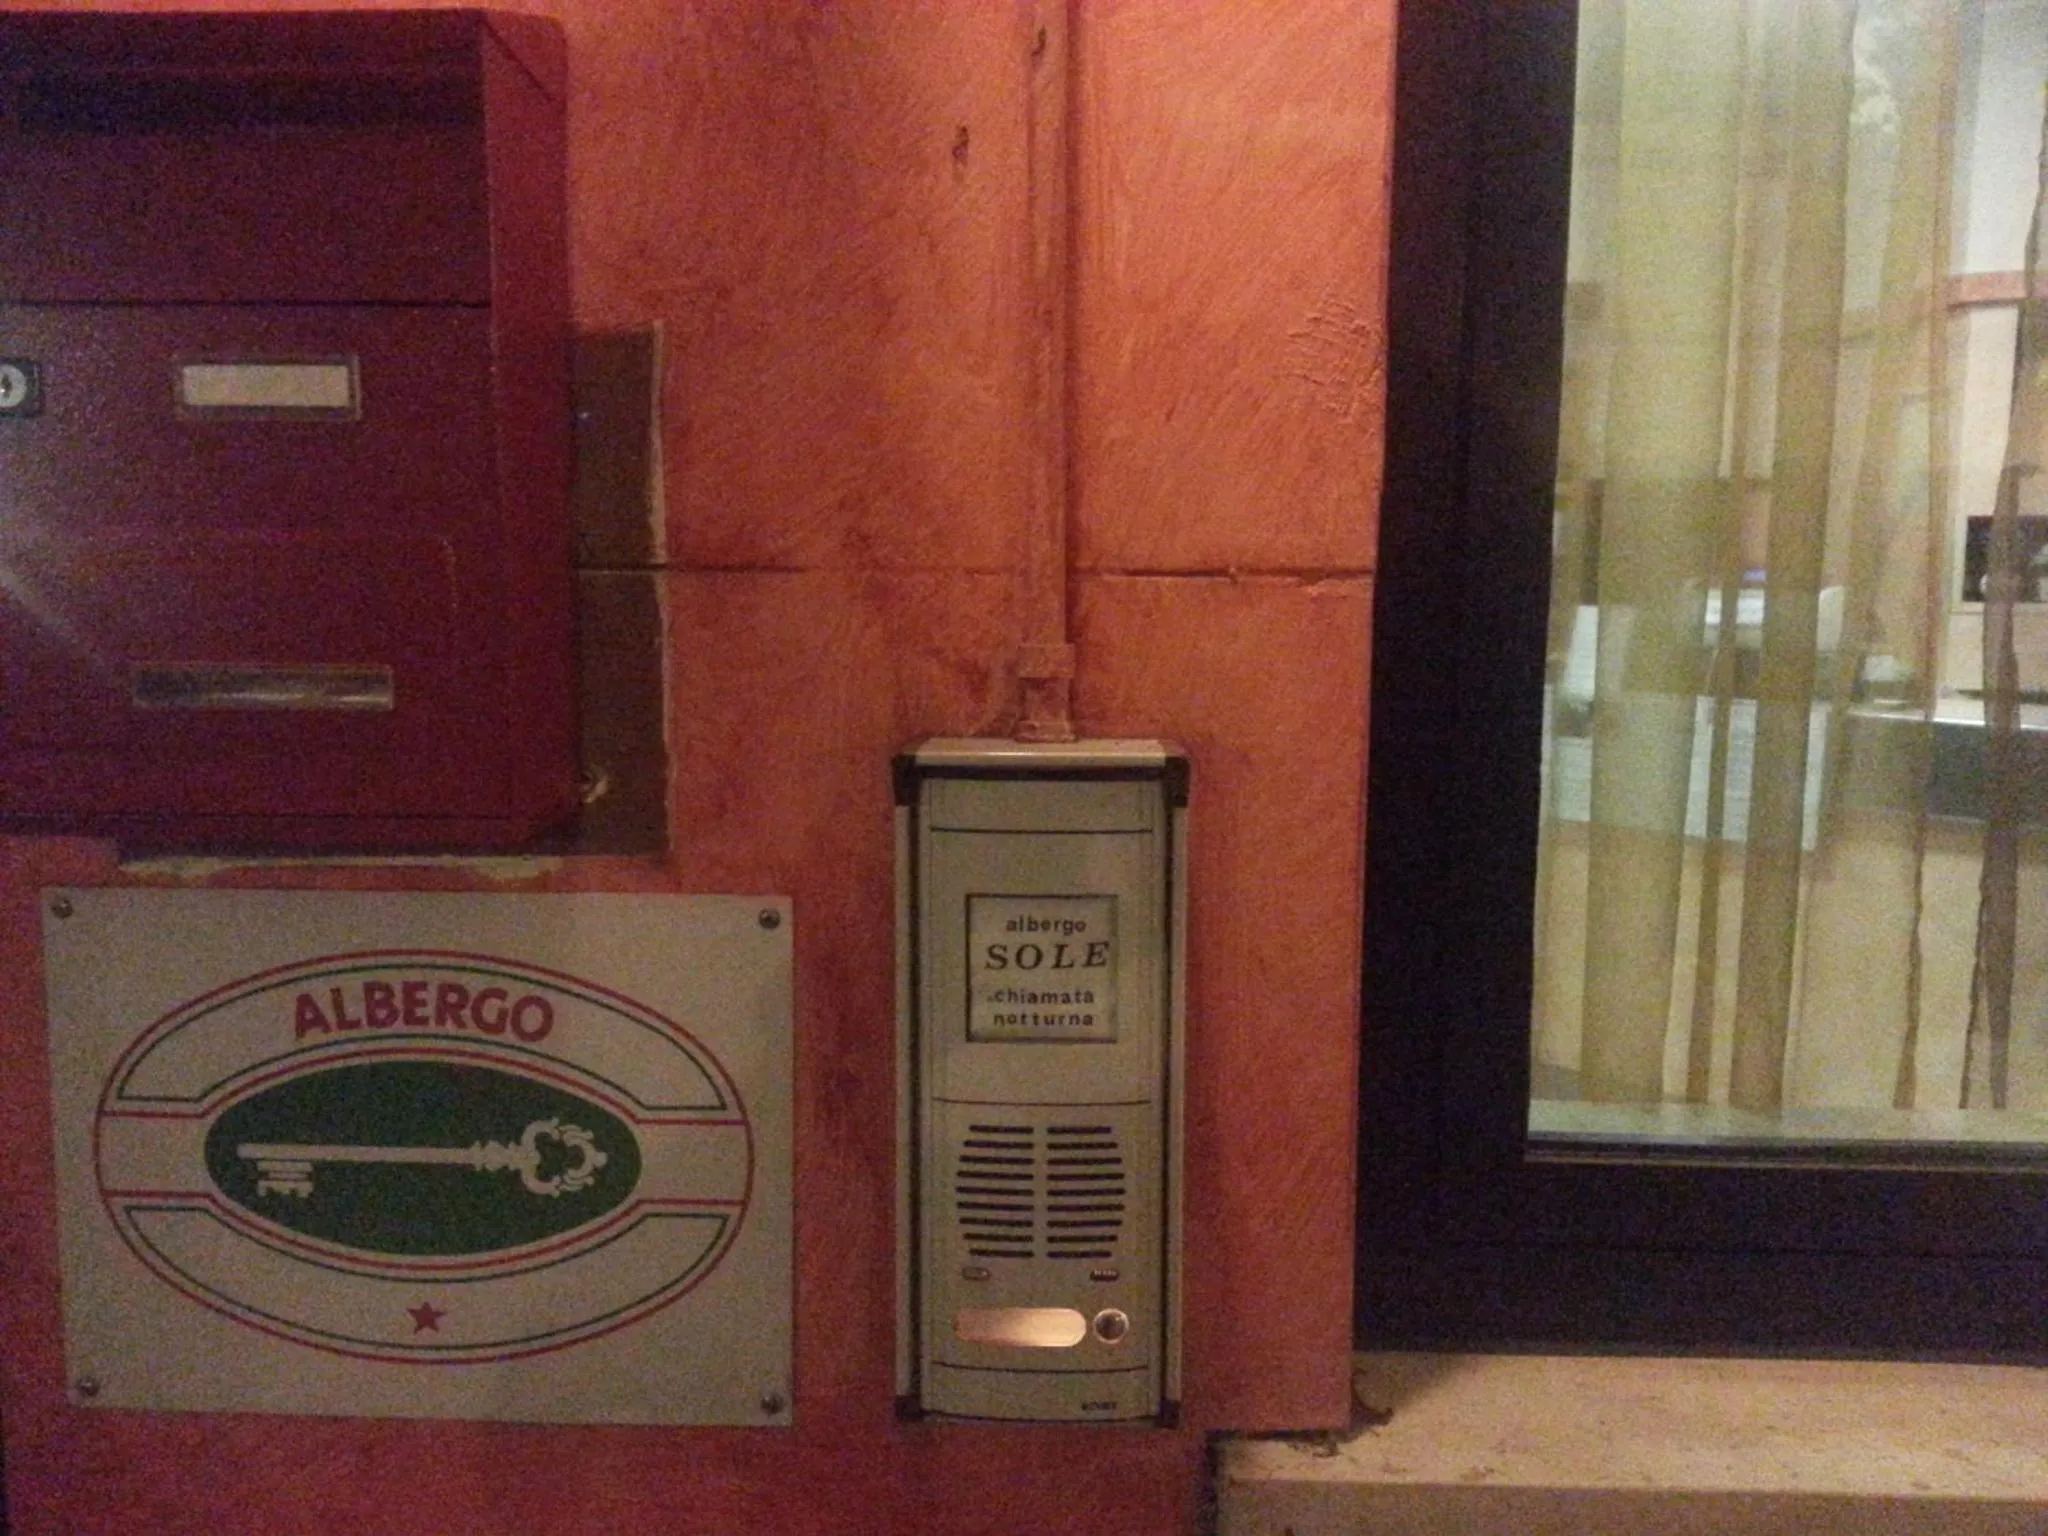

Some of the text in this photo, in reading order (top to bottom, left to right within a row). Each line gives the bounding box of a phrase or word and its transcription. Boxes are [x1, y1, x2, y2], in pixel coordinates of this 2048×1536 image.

[1006, 914, 1087, 936] albergo
[984, 941, 1110, 970] SOLE
[993, 987, 1095, 1005] chiamata
[294, 980, 554, 1042] ALBERGO
[993, 1011, 1094, 1027] notturna
